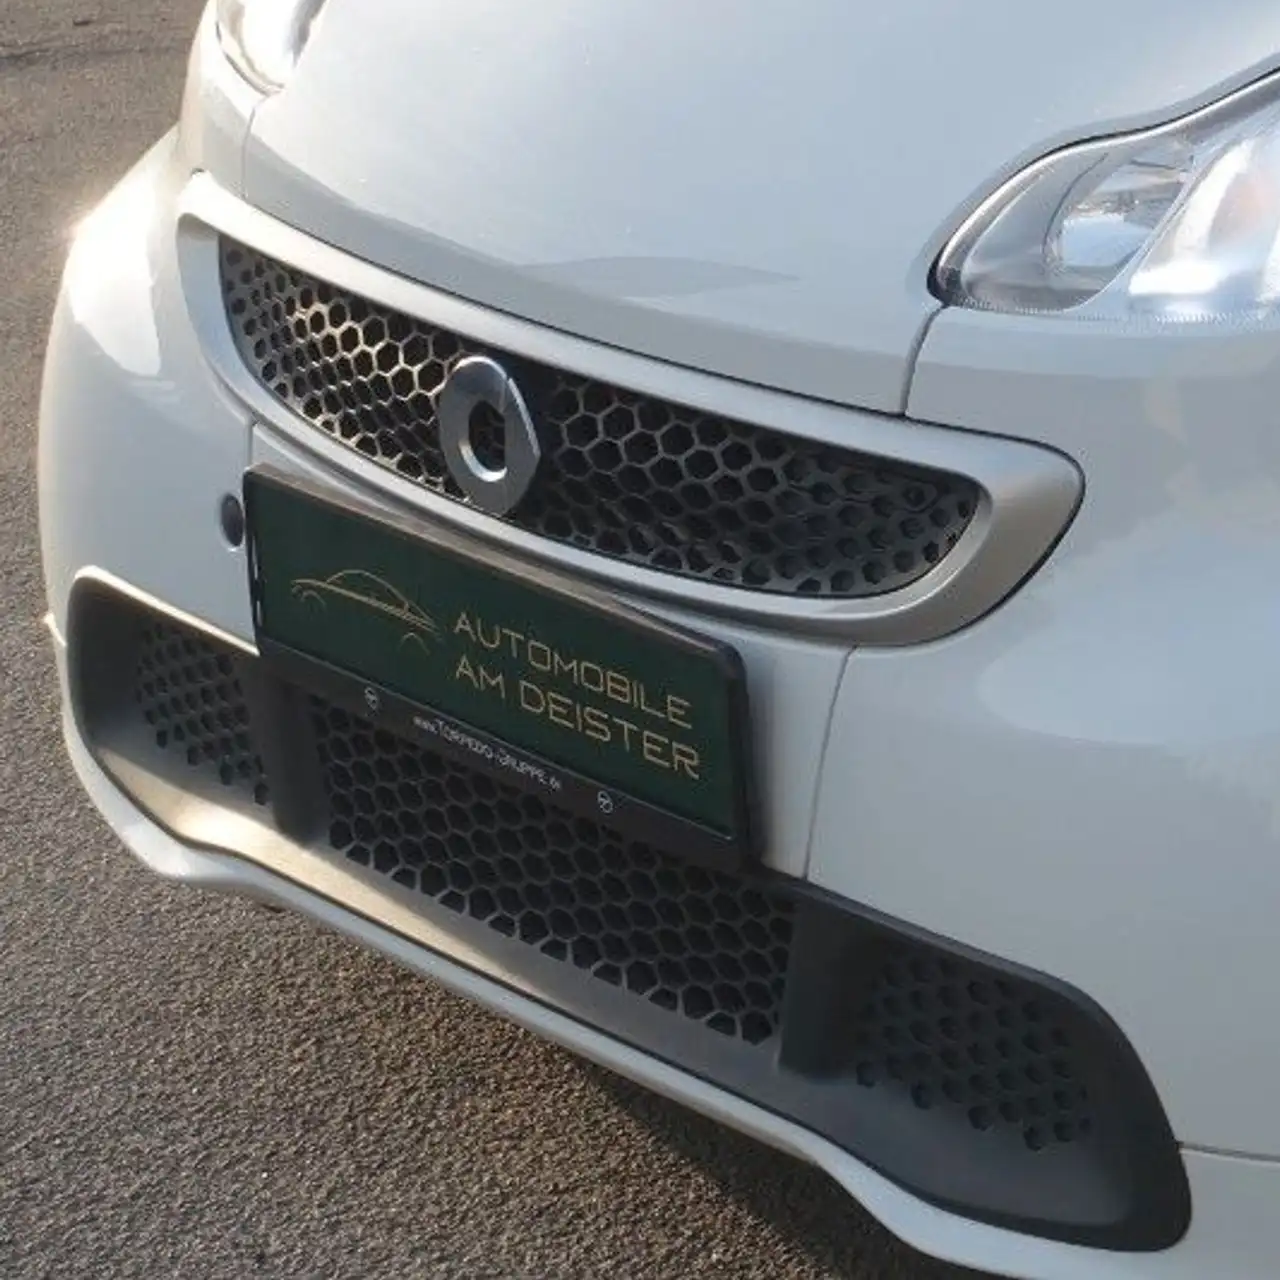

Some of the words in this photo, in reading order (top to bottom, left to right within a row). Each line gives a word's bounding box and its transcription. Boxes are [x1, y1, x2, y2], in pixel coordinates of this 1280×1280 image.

[454, 611, 693, 730] AUTOMOBILE
[456, 654, 506, 700] AM
[519, 679, 700, 780] DEISTER
